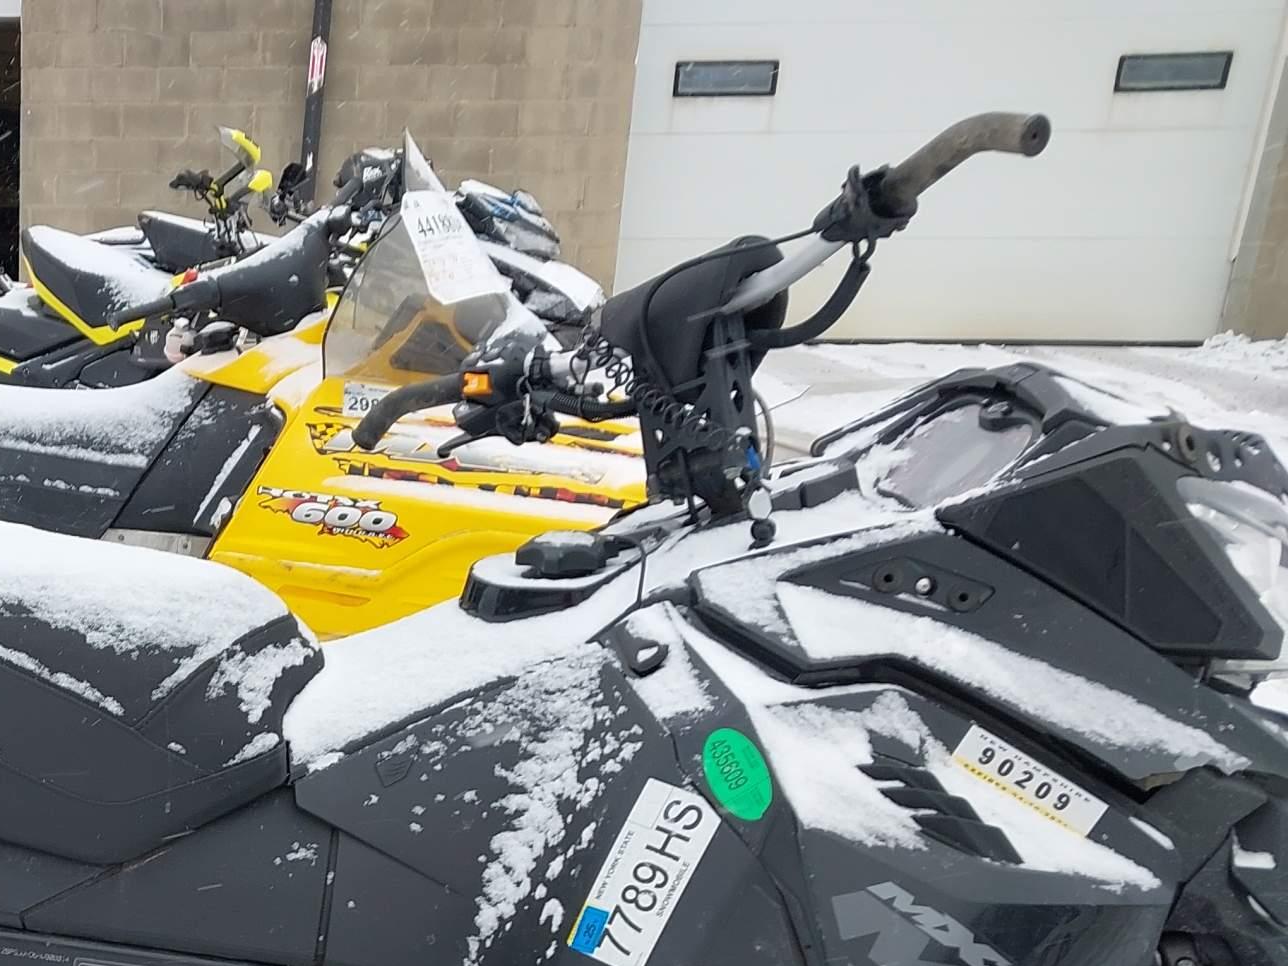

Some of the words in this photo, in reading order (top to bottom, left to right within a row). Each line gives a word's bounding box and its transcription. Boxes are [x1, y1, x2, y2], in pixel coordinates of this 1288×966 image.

[291, 501, 398, 531] 600
[978, 747, 1071, 811] 90209
[595, 880, 608, 900] NEW
[606, 856, 622, 879] YORK
[616, 830, 635, 856] STATE
[596, 862, 669, 956] 7789
[645, 799, 703, 862] HS
[655, 861, 691, 918] SNOWMOBILE
